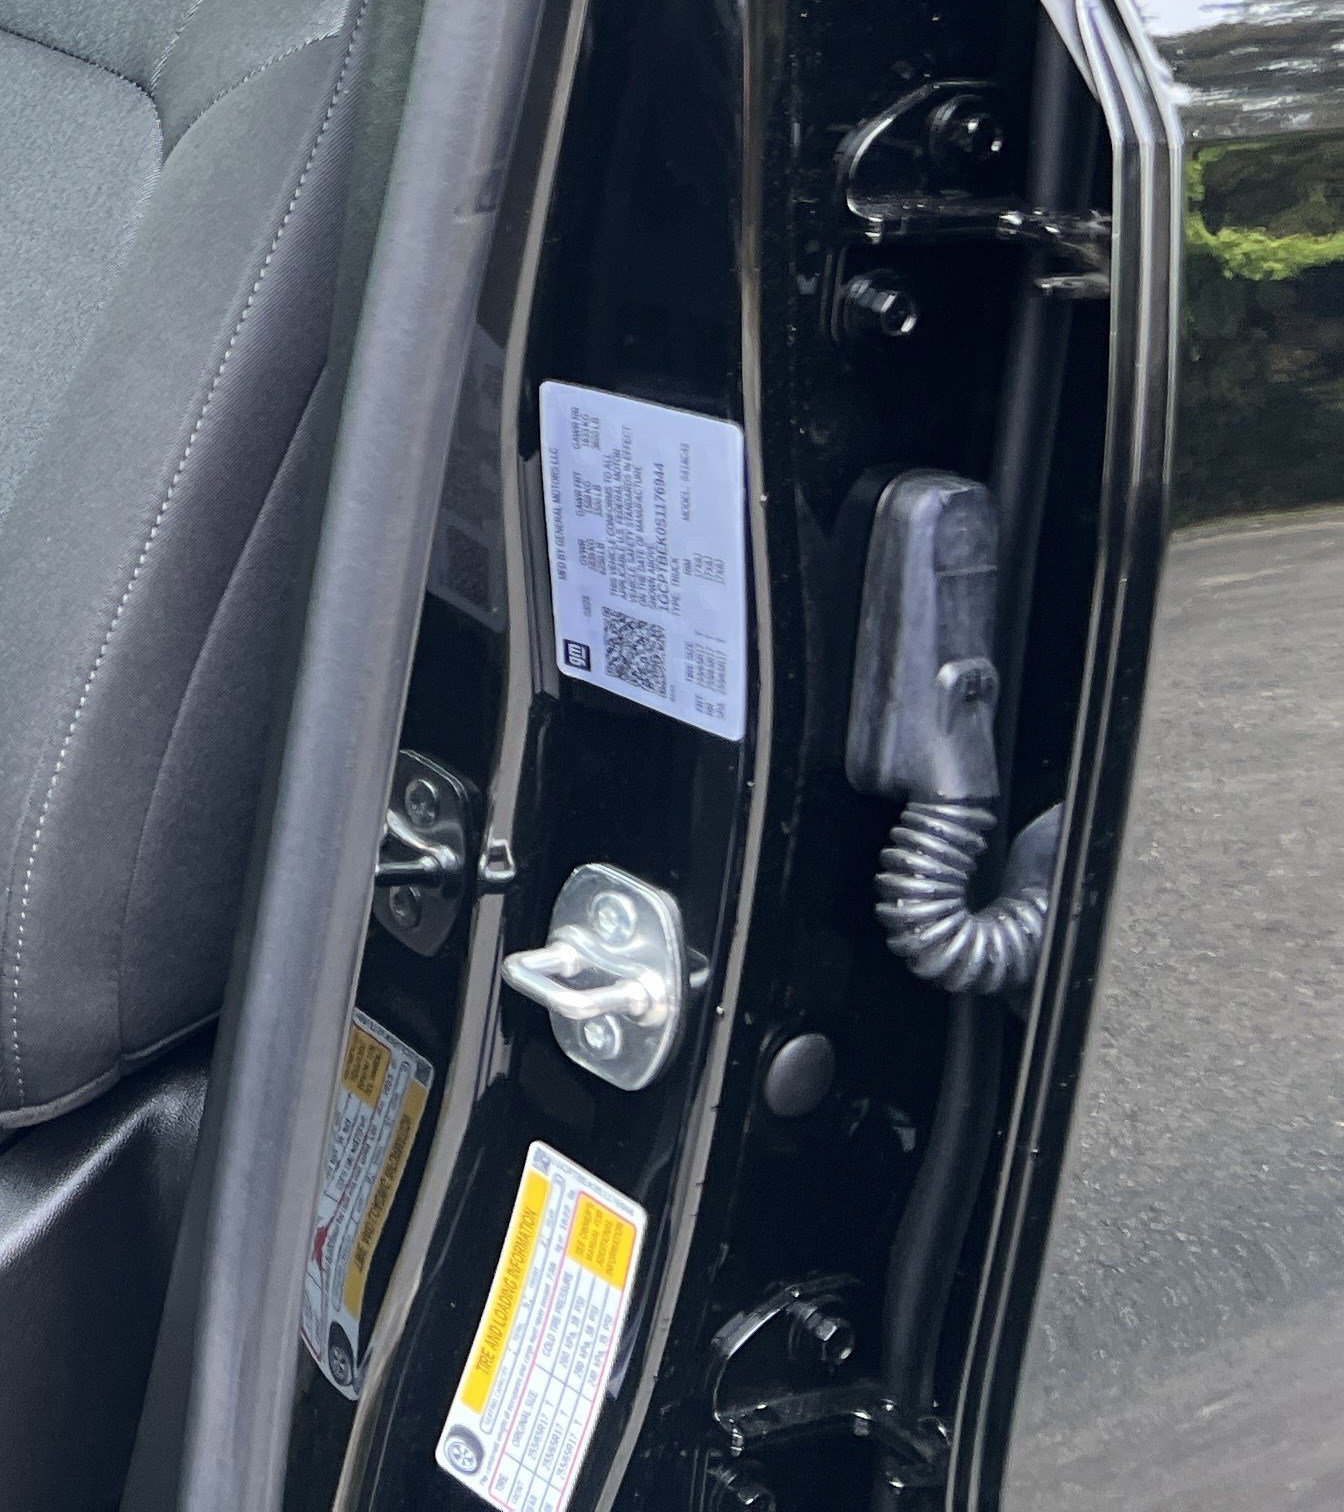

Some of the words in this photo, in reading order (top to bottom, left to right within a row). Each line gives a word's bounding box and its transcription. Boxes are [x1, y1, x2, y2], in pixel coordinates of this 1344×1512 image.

[549, 446, 559, 465] LLC
[610, 447, 621, 482] MOTOR
[550, 465, 561, 504] MOTORS
[622, 473, 634, 528] STANDARDS
[552, 504, 564, 547] GENERAL
[556, 547, 565, 561] BY
[636, 549, 645, 572] DATE
[637, 573, 646, 591] THE
[507, 1207, 538, 1280] INFORMATION
[495, 1279, 518, 1327] LOADING
[542, 1334, 556, 1357] COLD
[555, 1271, 574, 1314] PRESSURE
[484, 1325, 503, 1351] AND
[476, 1347, 495, 1376] TIRE
